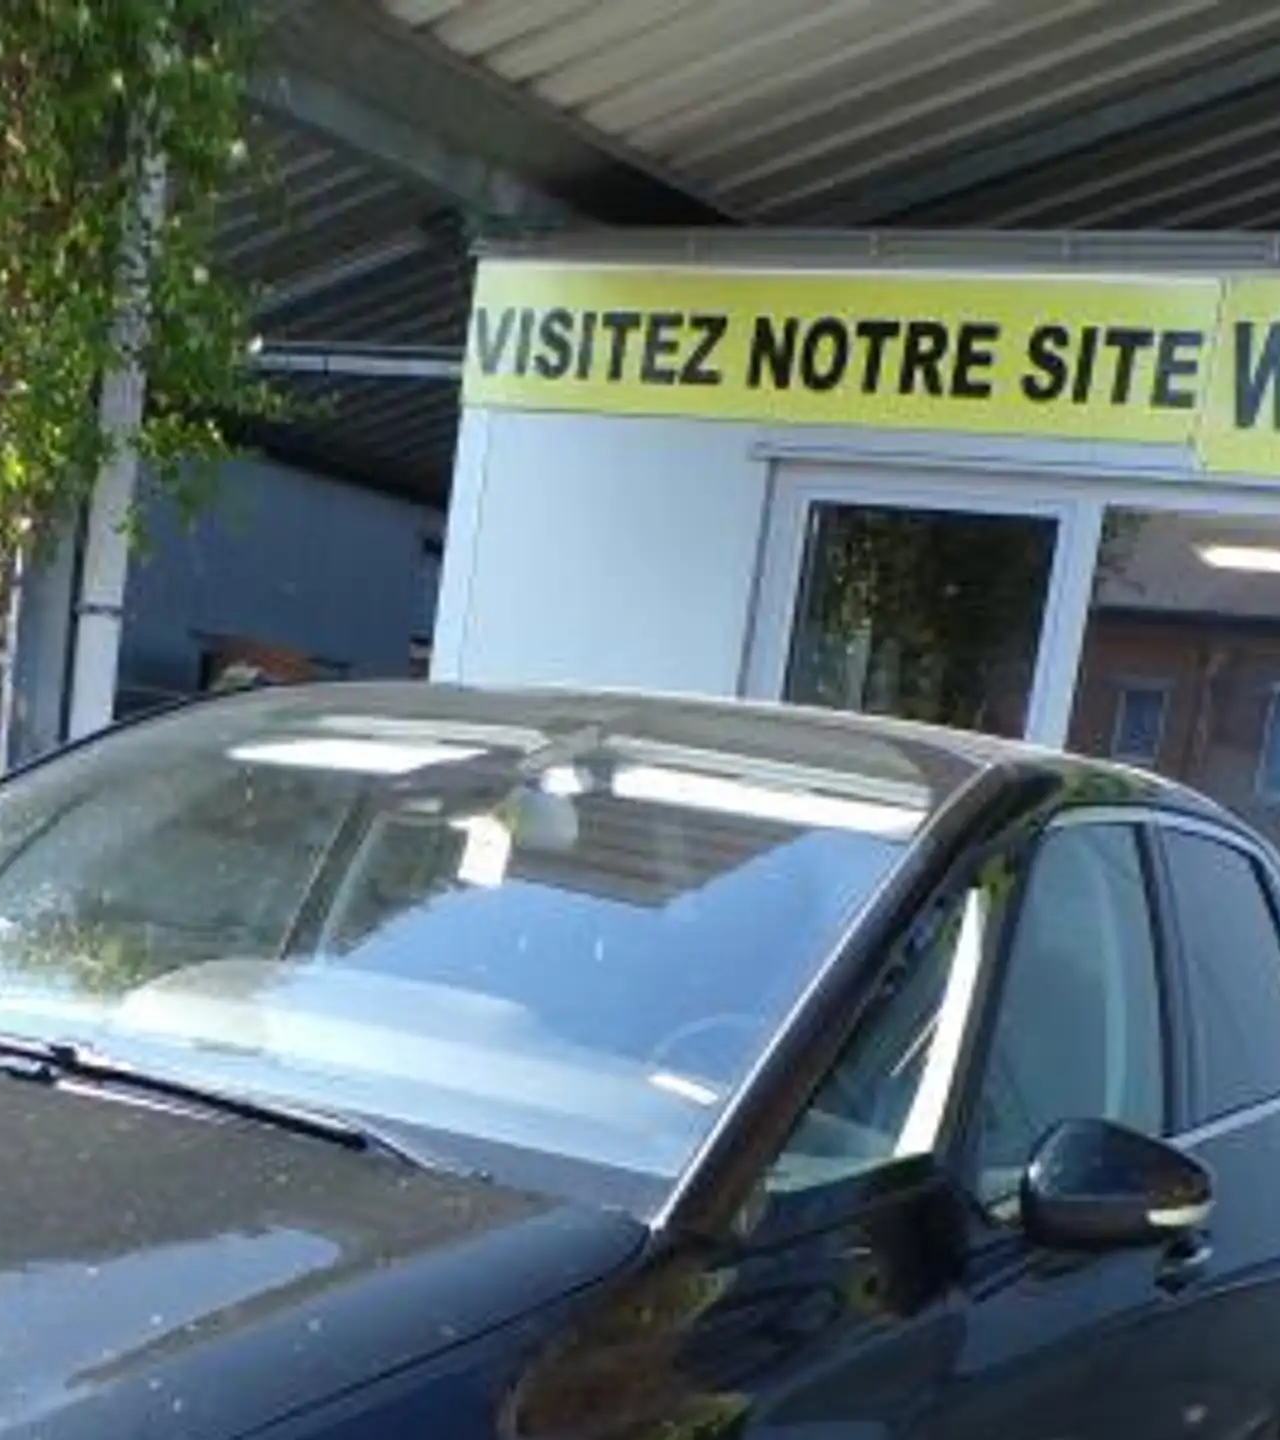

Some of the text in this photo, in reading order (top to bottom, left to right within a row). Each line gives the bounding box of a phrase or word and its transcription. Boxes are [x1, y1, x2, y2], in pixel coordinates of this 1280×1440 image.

[473, 304, 1205, 410] VISITEZ NOTRE SITE
